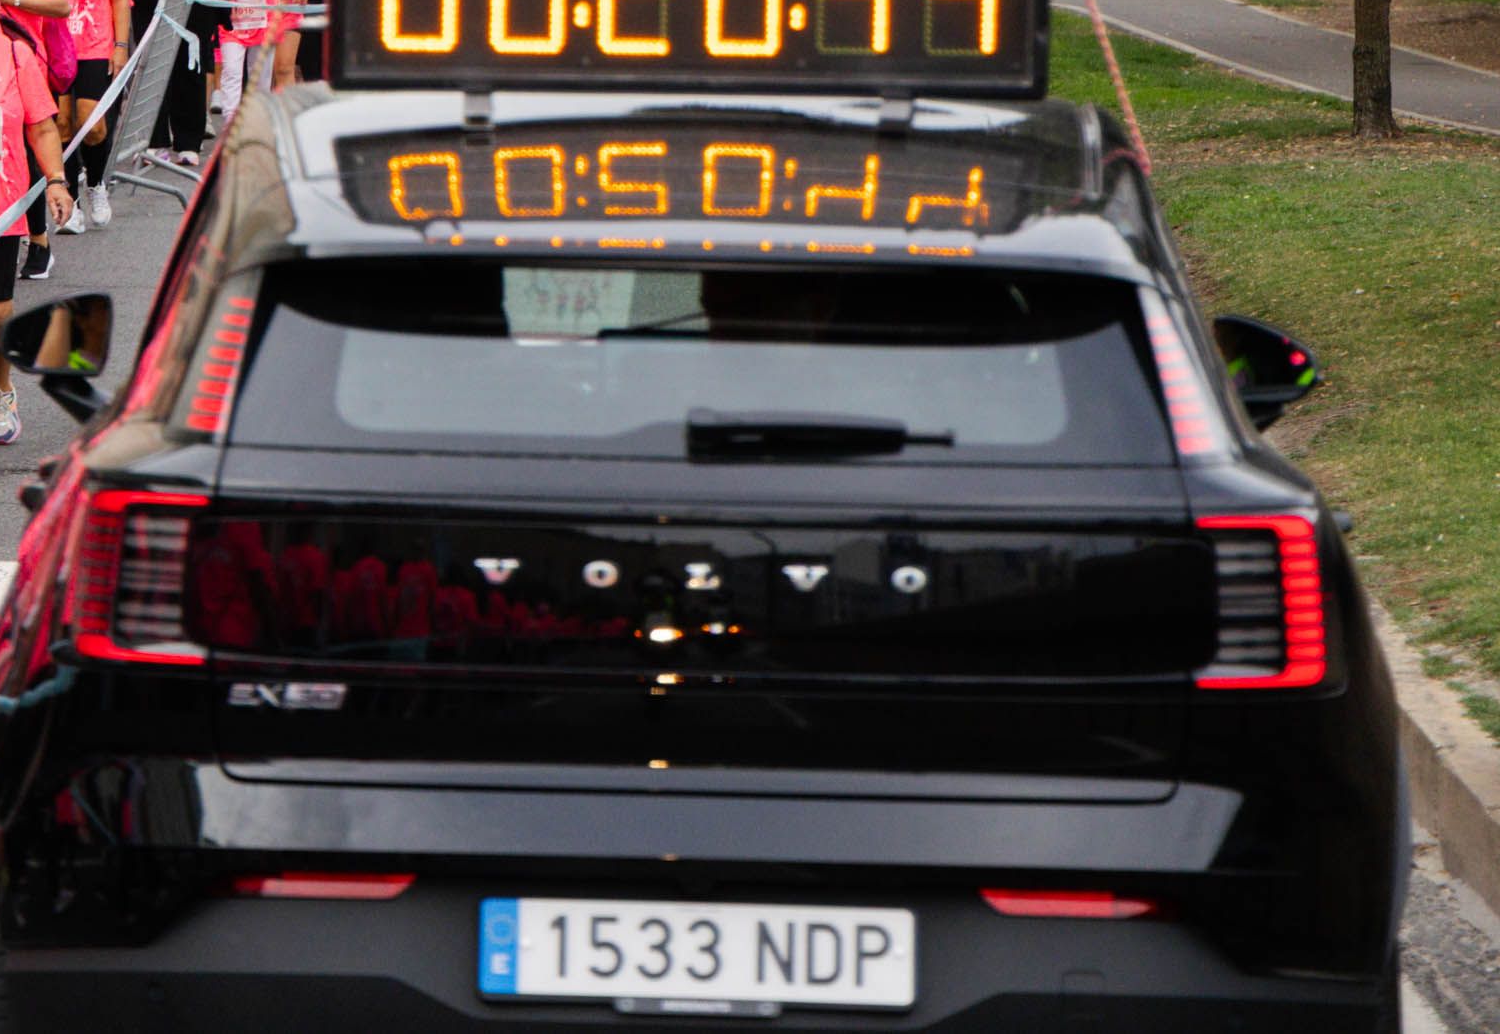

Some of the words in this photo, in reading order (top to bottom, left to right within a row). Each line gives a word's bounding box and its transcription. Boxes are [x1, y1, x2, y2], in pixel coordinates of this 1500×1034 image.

[473, 556, 928, 594] VOLVO
[490, 953, 510, 976] E
[550, 914, 722, 980] 1533
[756, 920, 892, 988] NDP
